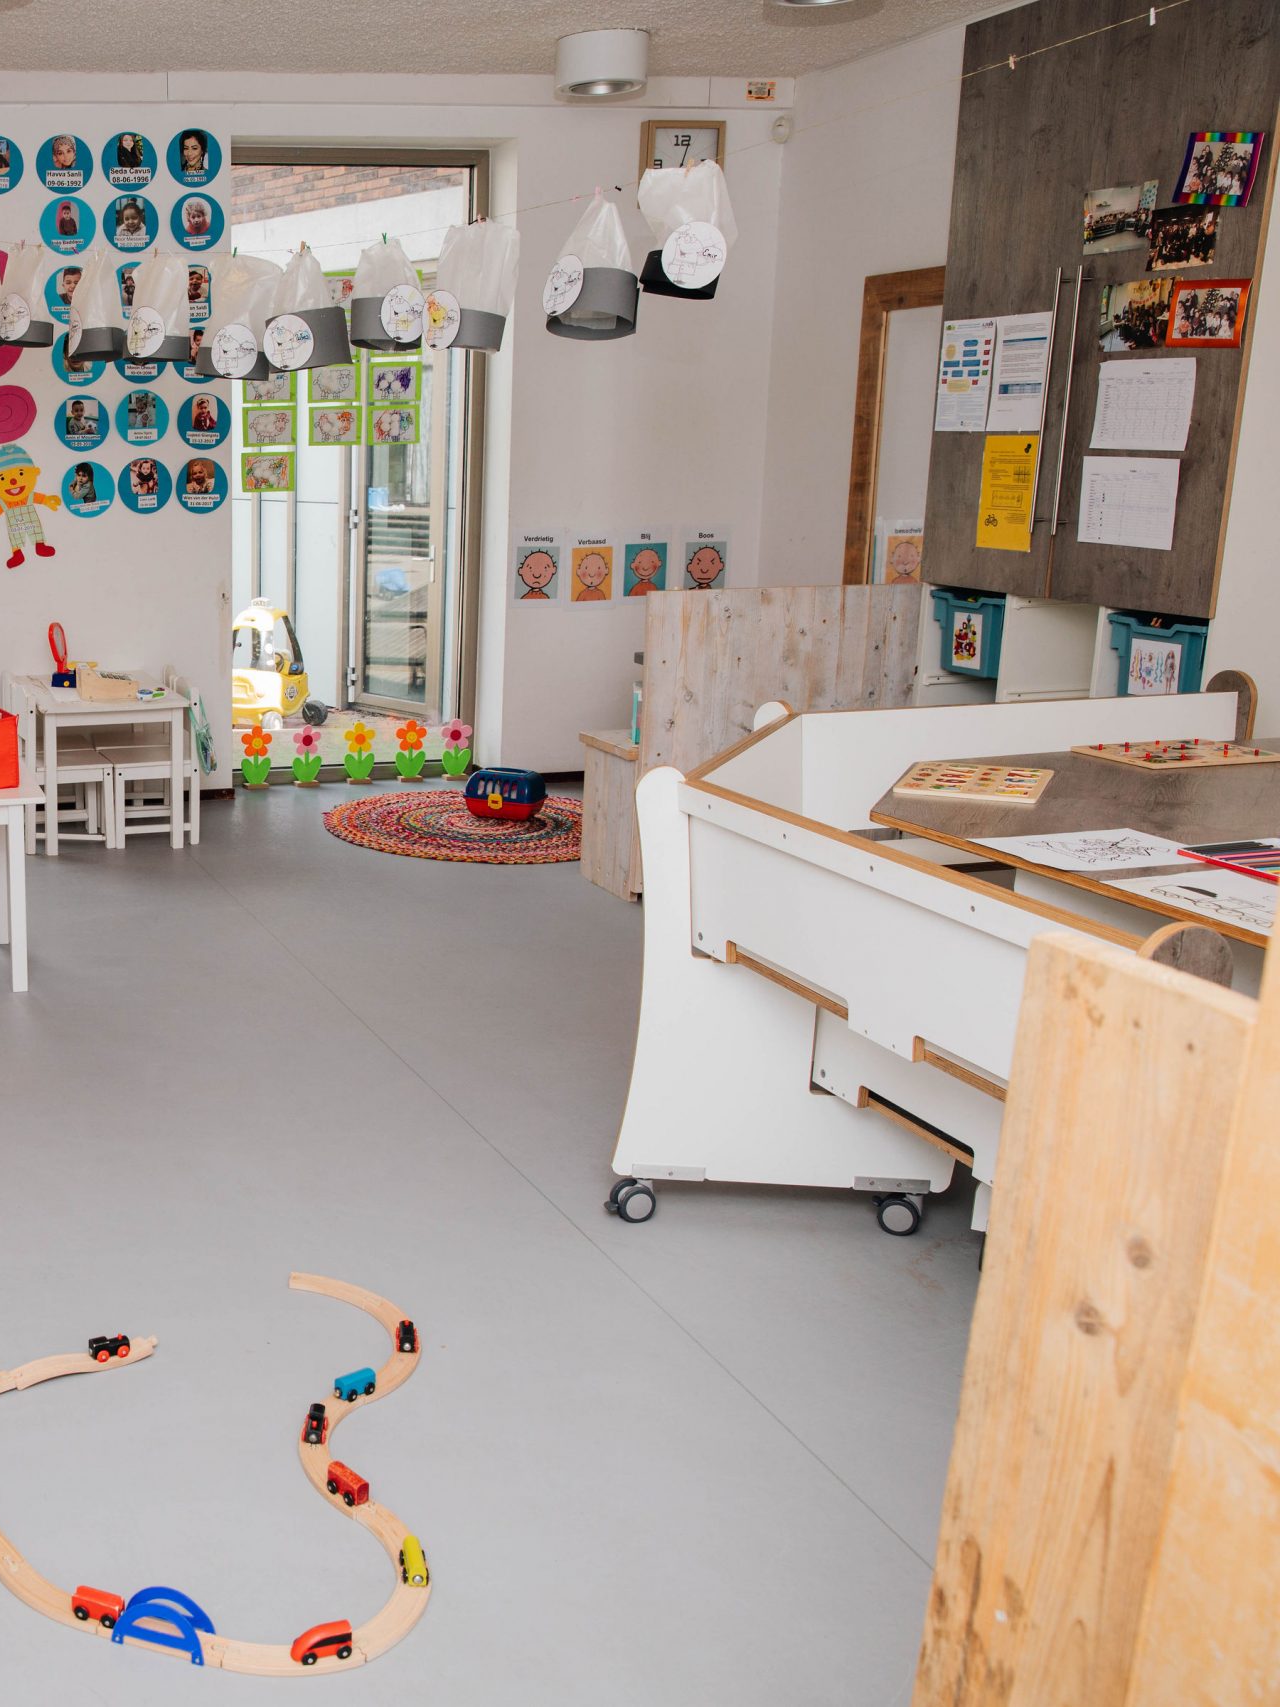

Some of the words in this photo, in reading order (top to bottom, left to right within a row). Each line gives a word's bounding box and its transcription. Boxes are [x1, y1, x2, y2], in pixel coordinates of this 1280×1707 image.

[673, 134, 691, 147] 12
[110, 167, 128, 175] Seda
[129, 167, 151, 175] Cavus
[524, 535, 554, 543] Verdrietig
[640, 533, 651, 541] Blij
